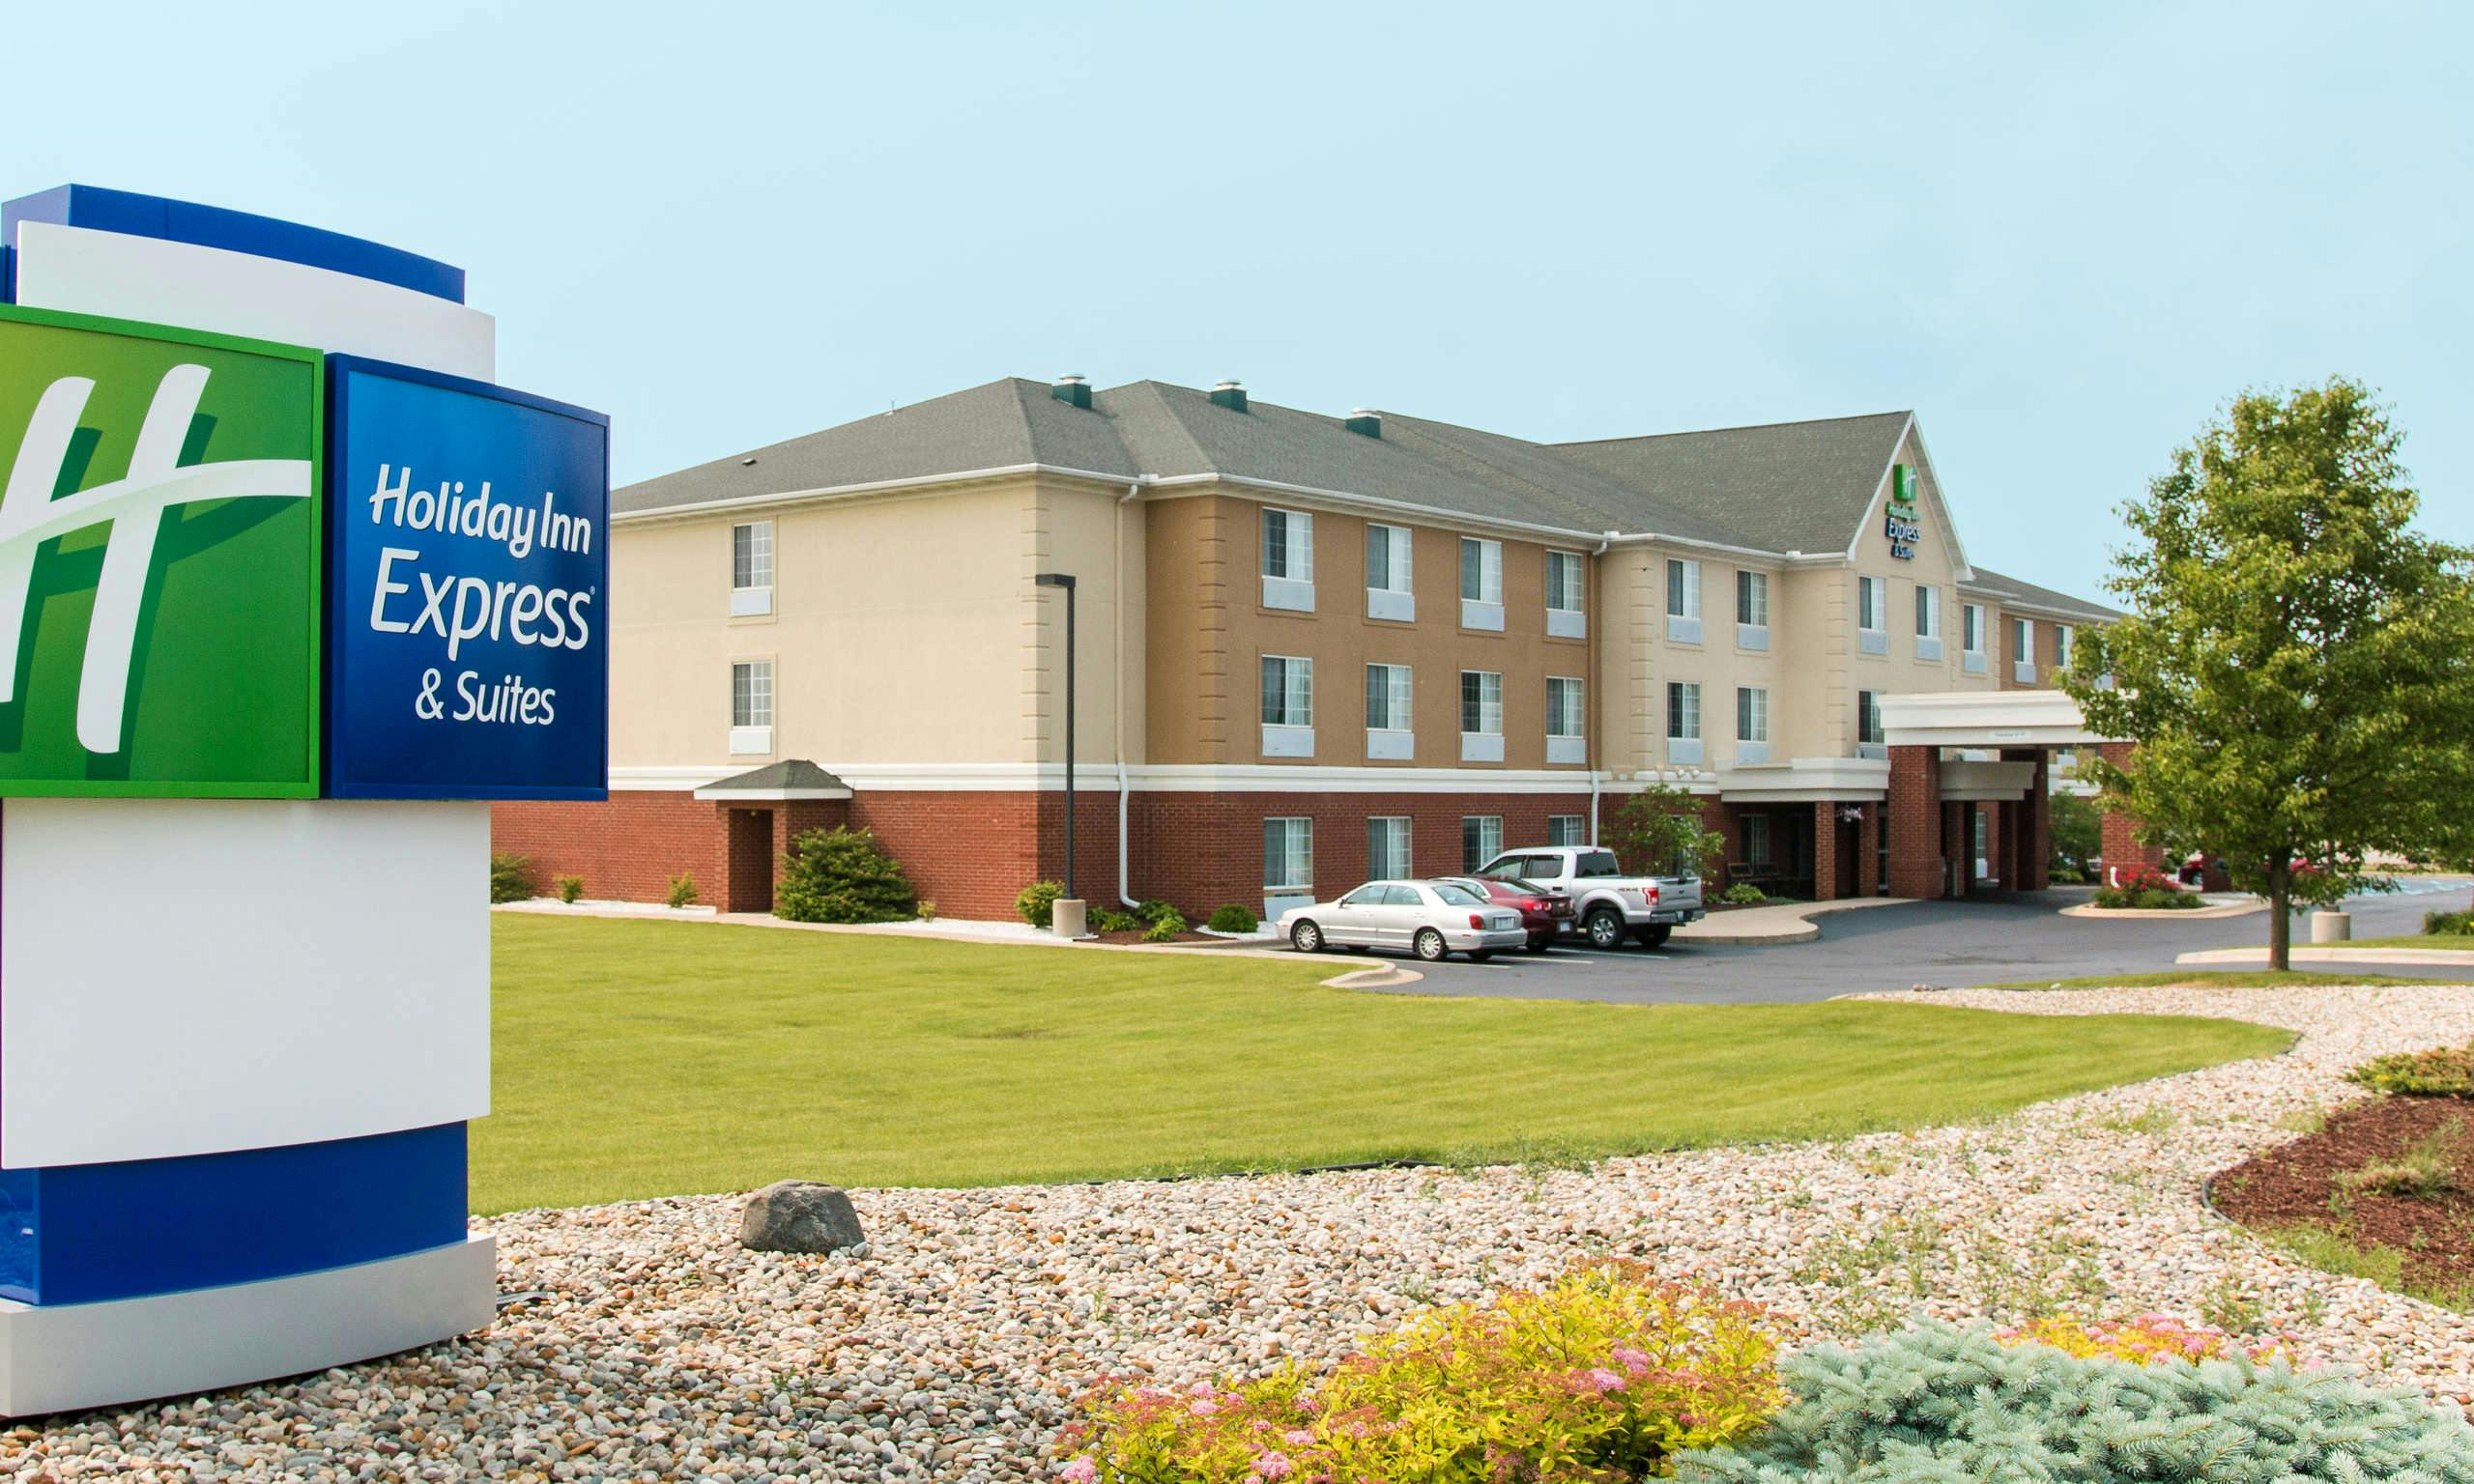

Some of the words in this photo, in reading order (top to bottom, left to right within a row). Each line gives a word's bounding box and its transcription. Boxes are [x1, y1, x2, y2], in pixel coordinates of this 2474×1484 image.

[0, 363, 312, 754] H
[368, 463, 536, 559] Holiday
[539, 491, 591, 556] Inn
[1887, 517, 1920, 543] Express
[369, 546, 592, 662] Express
[415, 667, 445, 721] &
[452, 670, 557, 727] Suites
